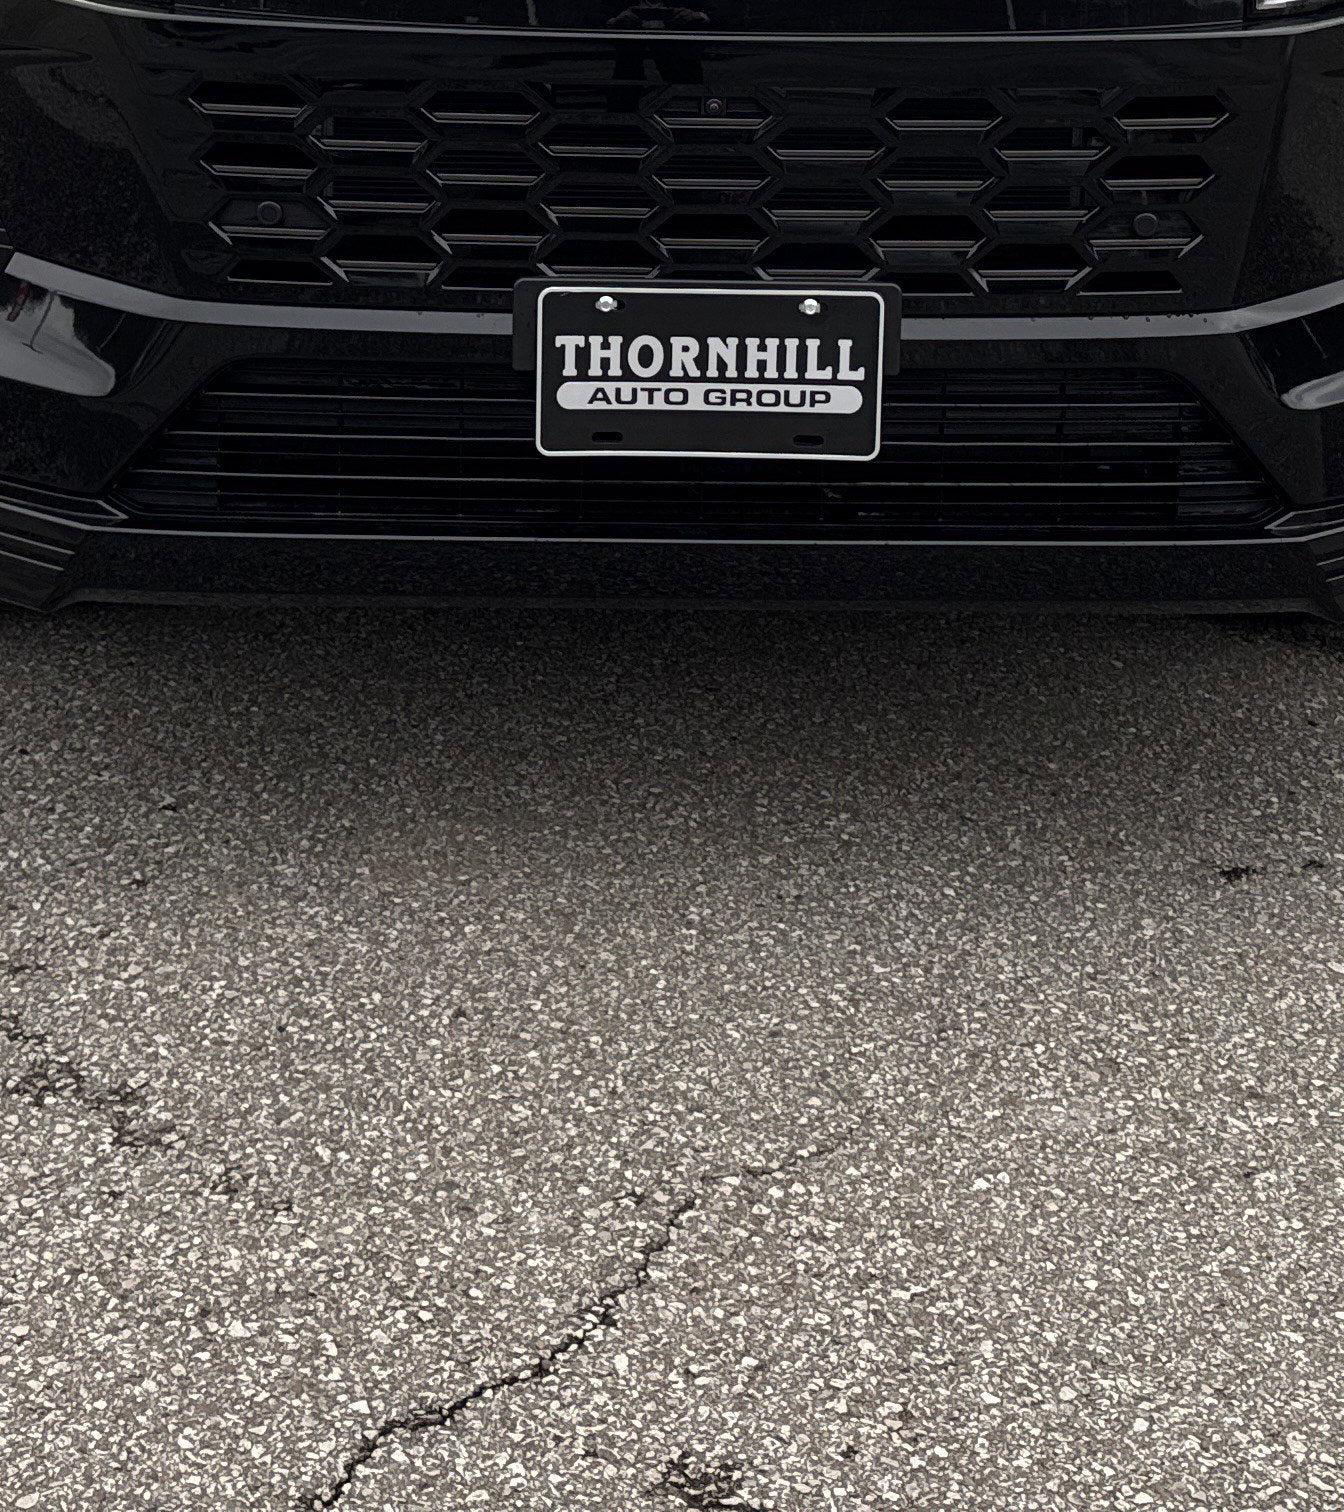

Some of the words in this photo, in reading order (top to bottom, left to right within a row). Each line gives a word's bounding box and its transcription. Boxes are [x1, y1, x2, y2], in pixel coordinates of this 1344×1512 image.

[554, 334, 866, 381] THORNHILL
[587, 387, 689, 406] AUTO
[703, 388, 832, 409] GROUP
